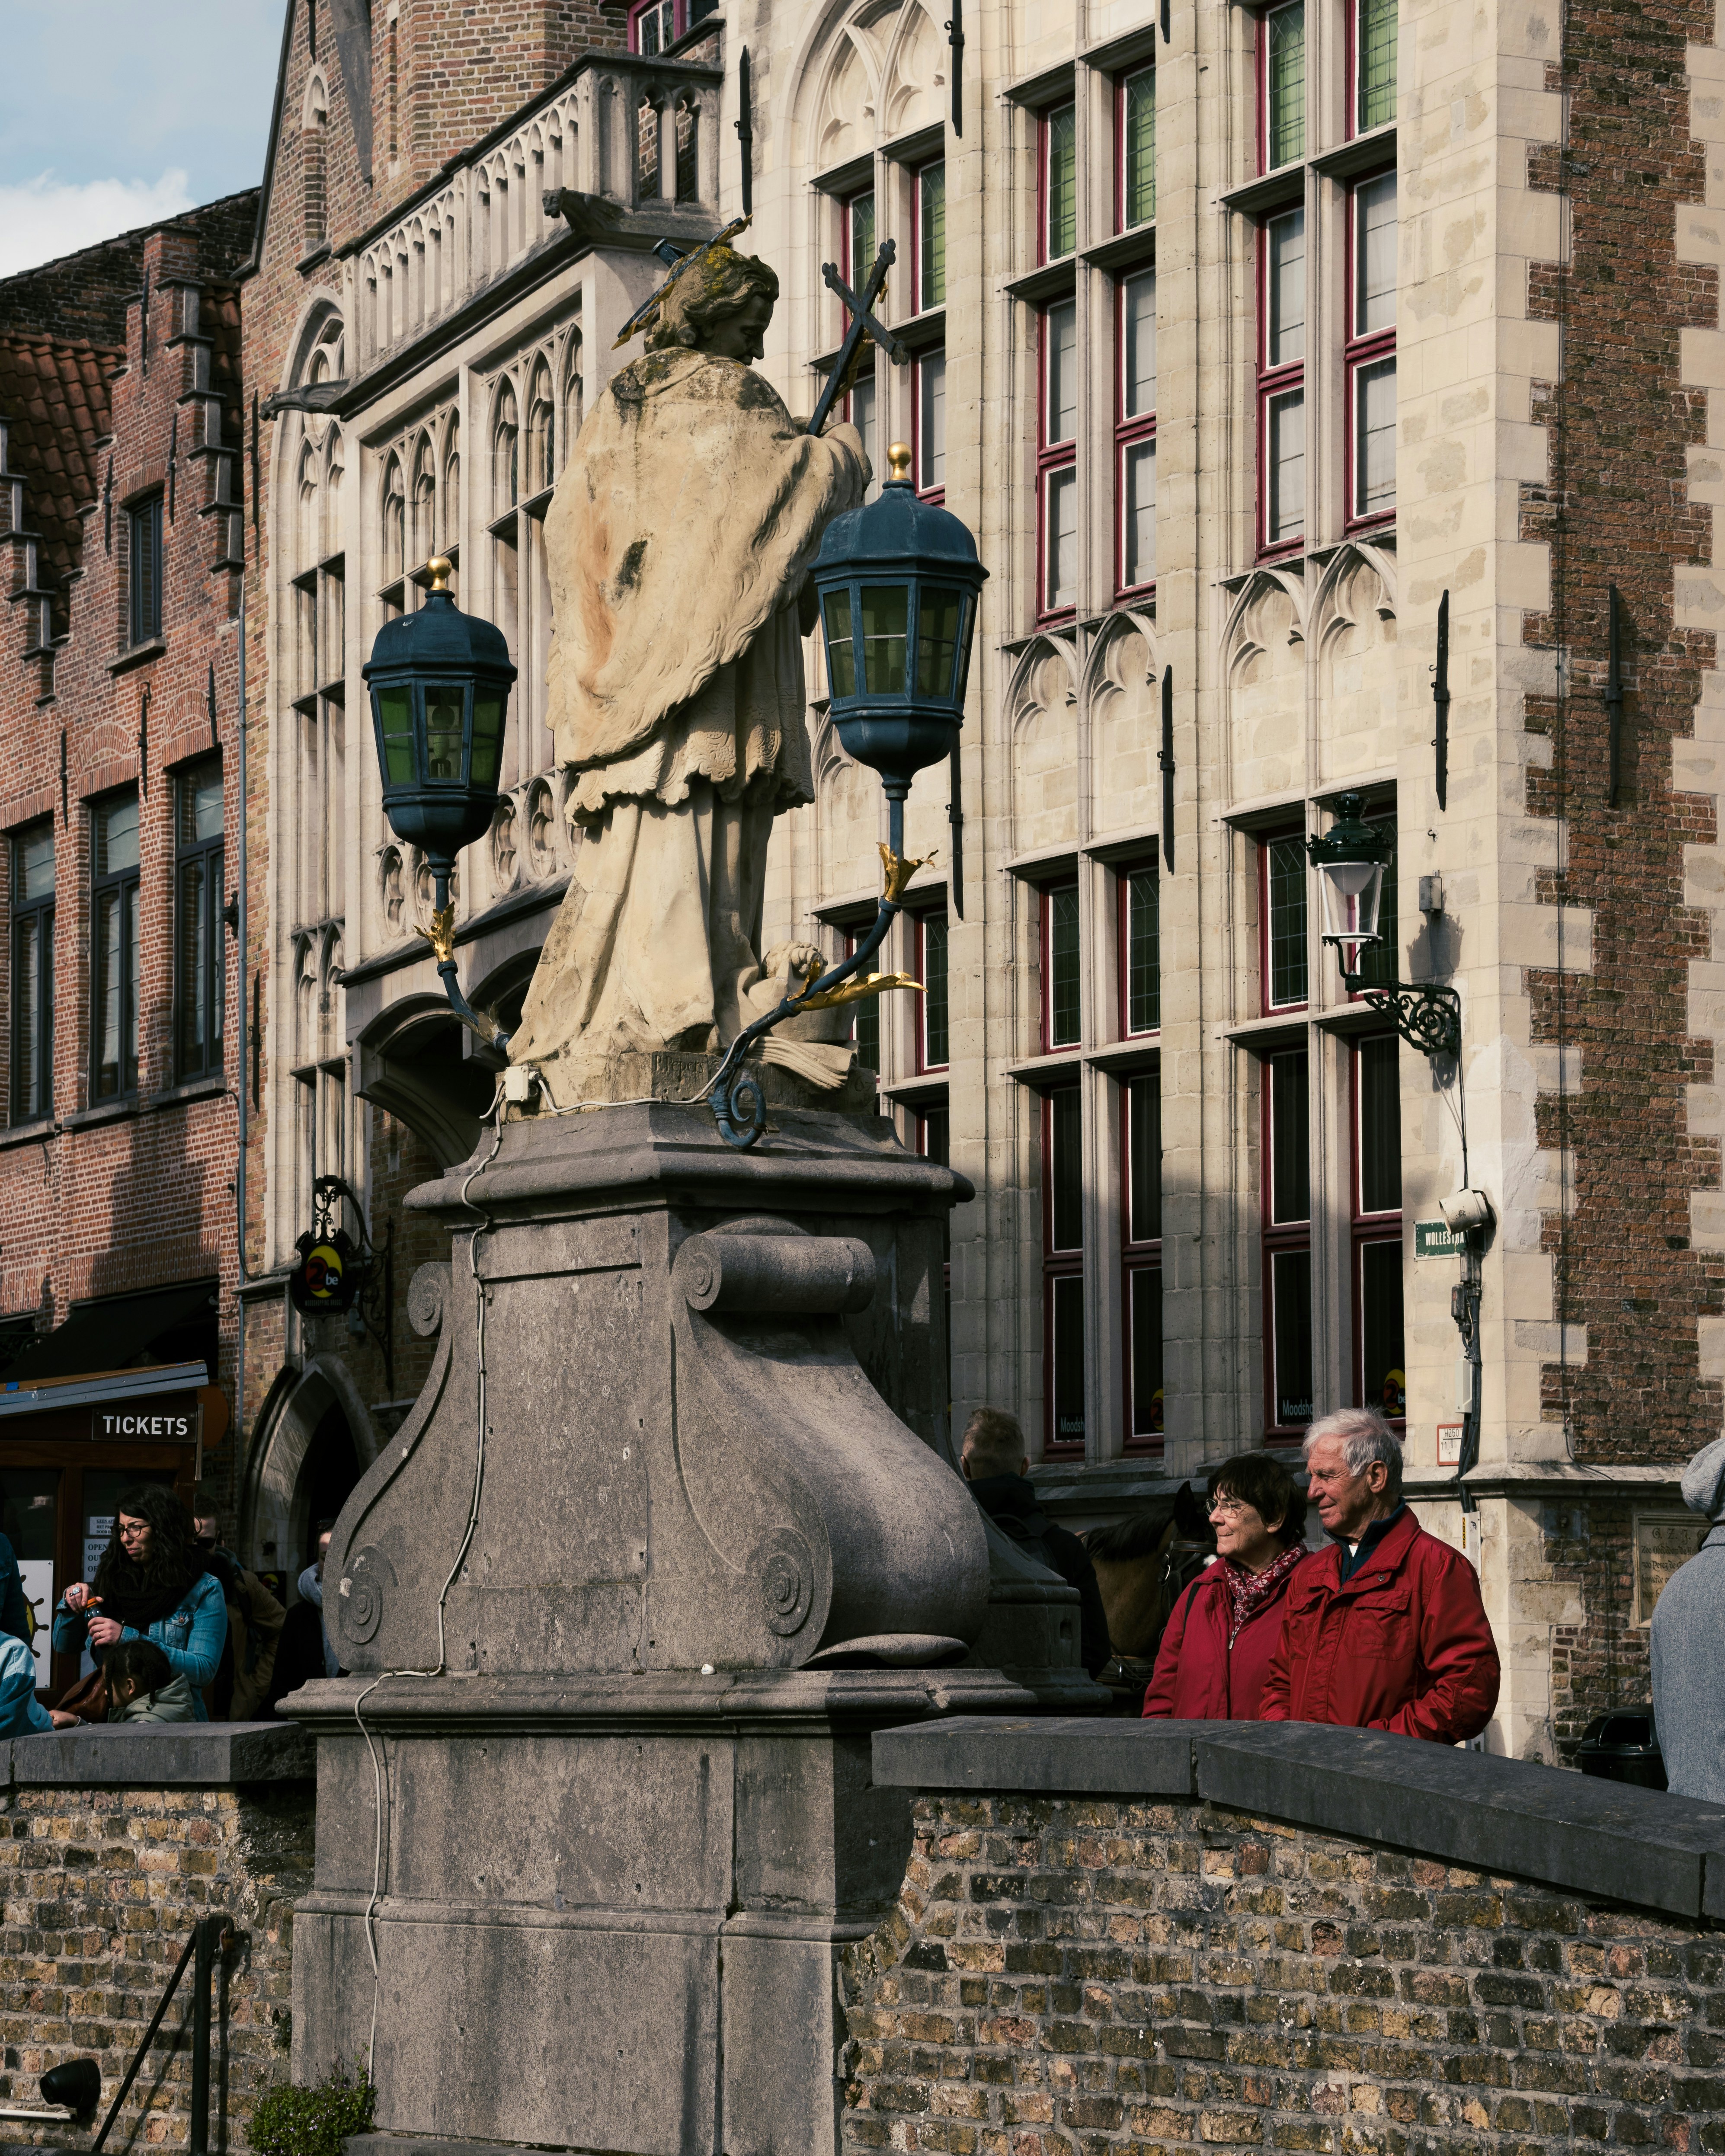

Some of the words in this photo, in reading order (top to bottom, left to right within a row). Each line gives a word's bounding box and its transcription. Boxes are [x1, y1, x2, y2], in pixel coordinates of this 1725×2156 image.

[1283, 1398, 1313, 1416] Moodsho
[102, 1415, 187, 1435] TICKETS
[1060, 1416, 1084, 1433] Moodsh
[1444, 1428, 1459, 1437] H250
